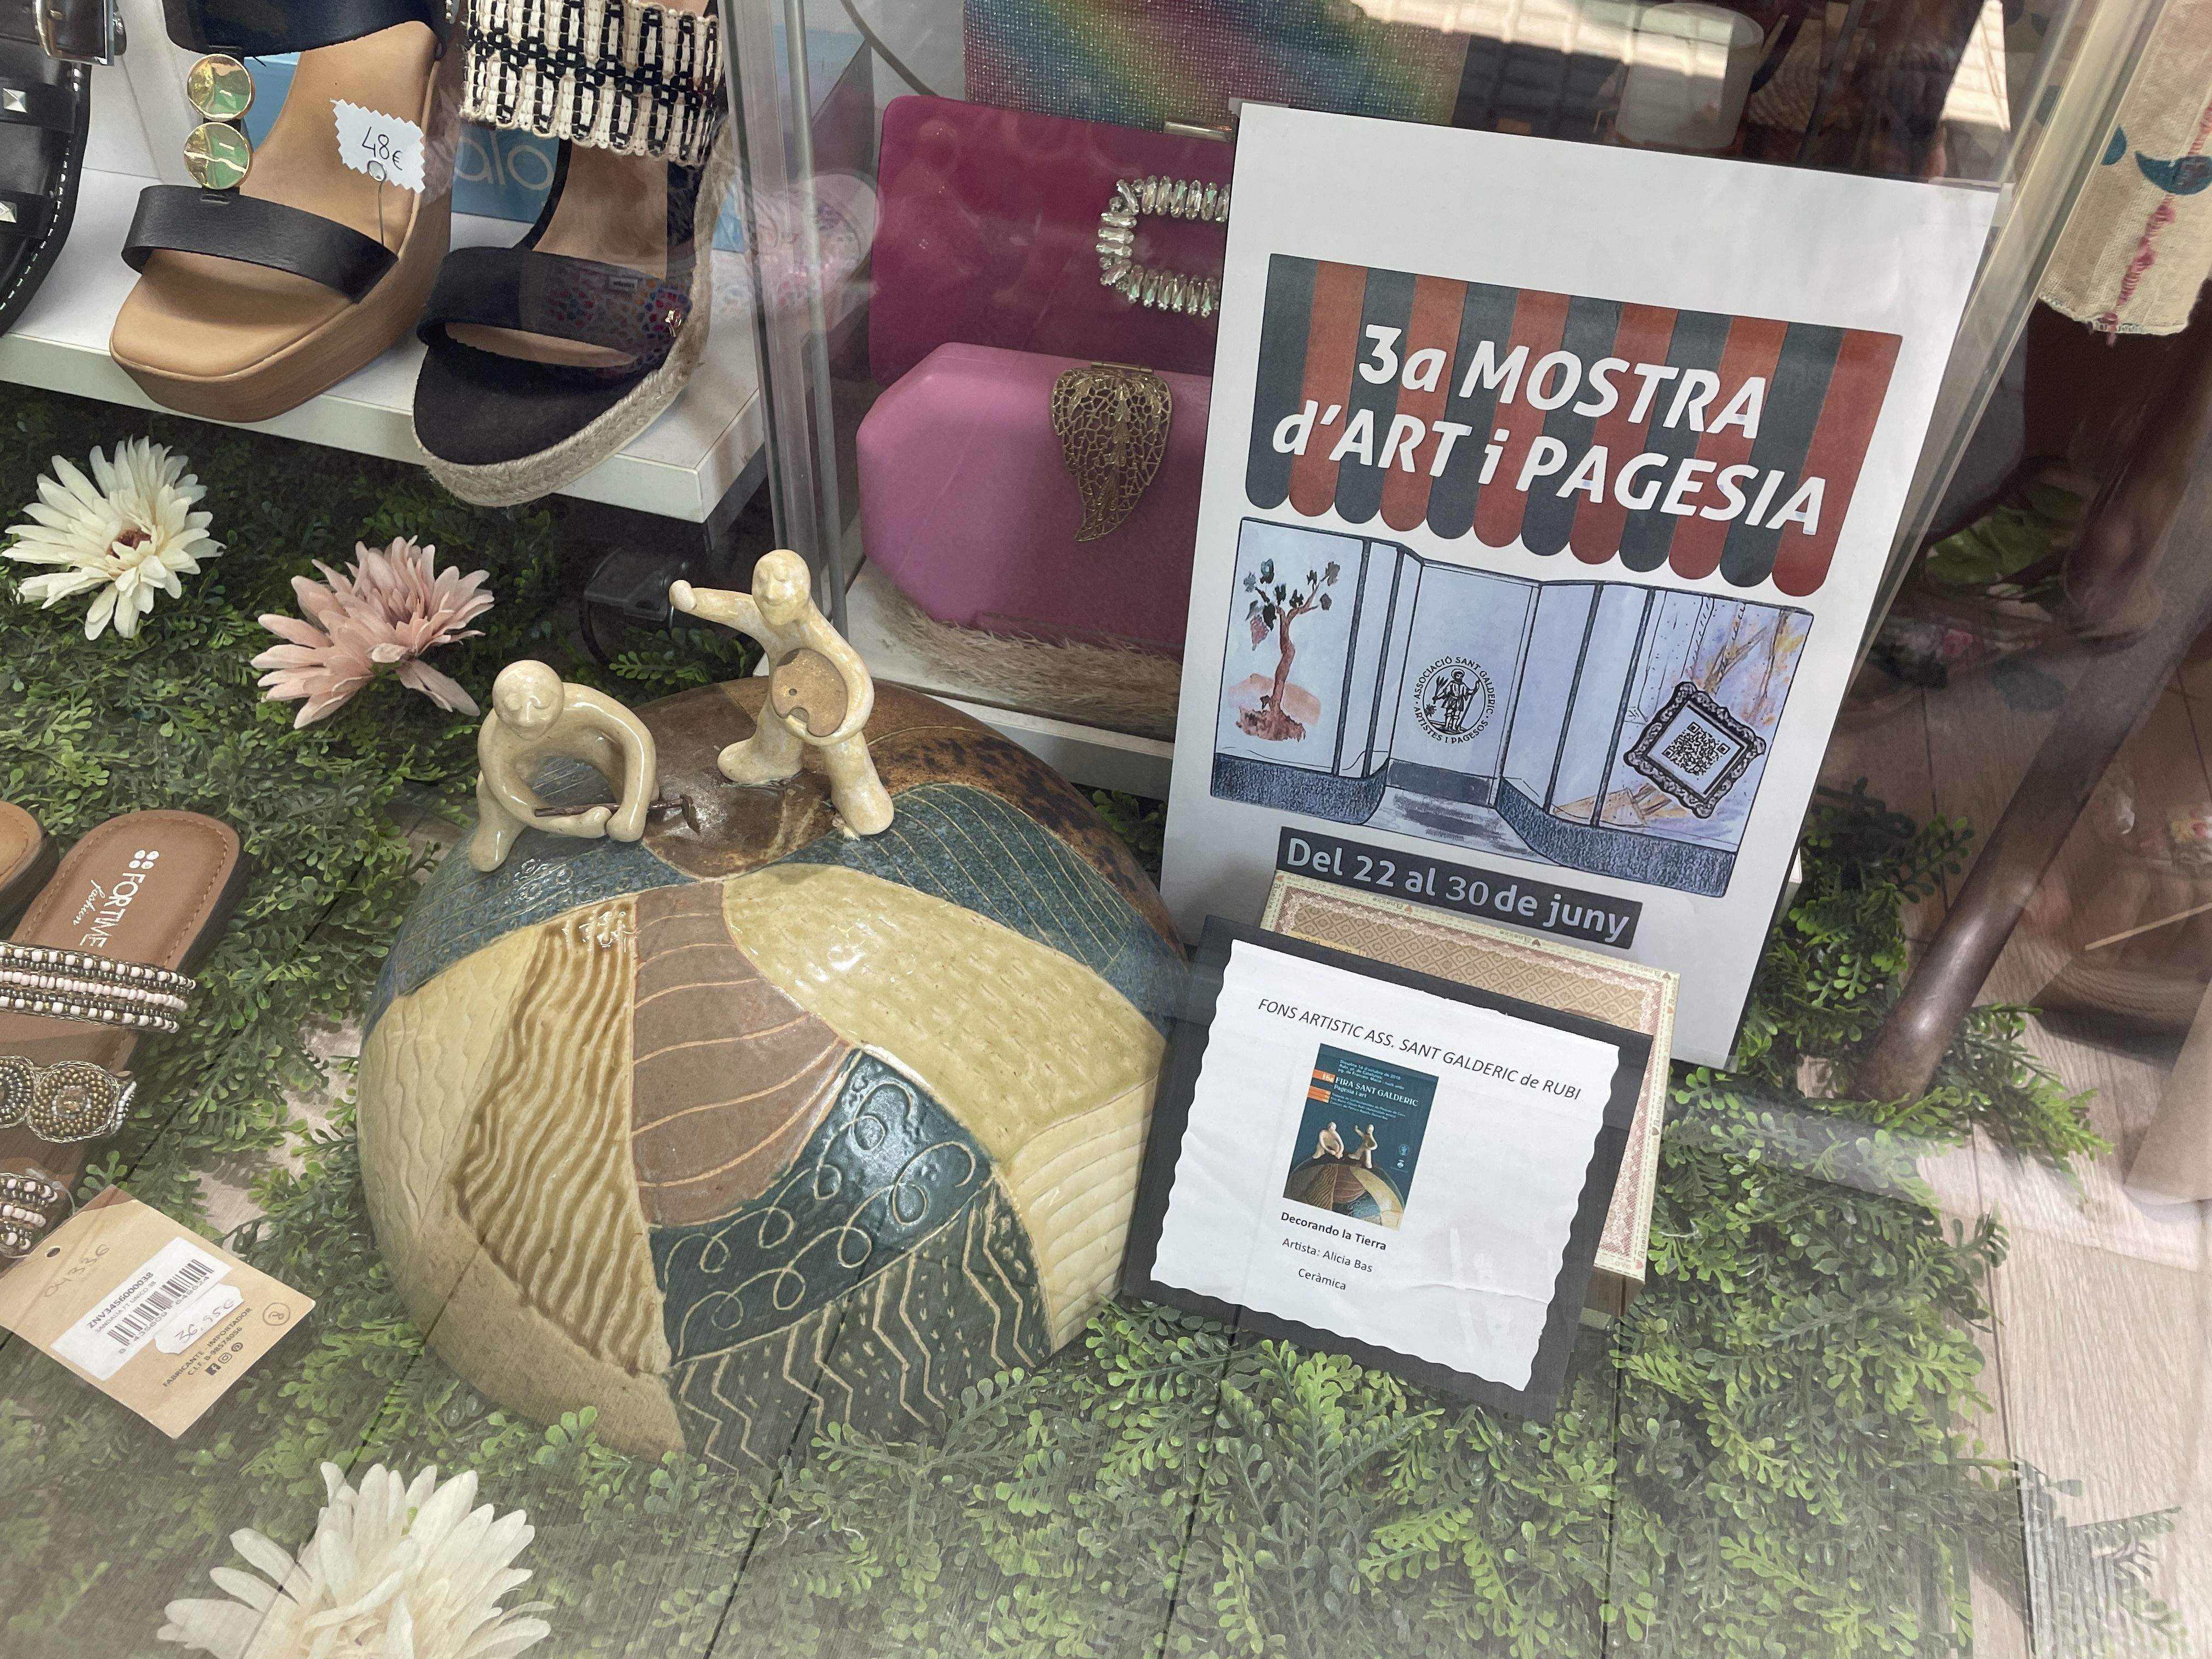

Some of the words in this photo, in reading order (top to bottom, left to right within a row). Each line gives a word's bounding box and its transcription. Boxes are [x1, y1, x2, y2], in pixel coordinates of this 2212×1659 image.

[362, 126, 403, 171] 48€
[1358, 324, 1447, 391] 3a
[1459, 340, 1767, 439] MOSTRA
[1272, 400, 1471, 477] d'ART
[1477, 428, 1508, 484] i
[1515, 435, 1827, 536] PAGESIA
[1414, 656, 1452, 699] ASSOCIACIÓ
[1455, 657, 1481, 671] SANT
[1480, 670, 1496, 714] GALDERIC
[1414, 707, 1443, 741] ARTISTES
[1451, 720, 1488, 744] PAGESOS
[1286, 837, 1343, 876] Del
[1353, 854, 1396, 888] 22
[1404, 867, 1436, 896] al
[1445, 876, 1488, 907] 30
[1495, 883, 1538, 917] de
[1543, 893, 1629, 942] juny
[1258, 998, 1297, 1019] FONS
[1299, 1011, 1364, 1039] ARTISTIC
[1364, 1029, 1395, 1048] ASS.
[1399, 1038, 1442, 1060] SANT
[1443, 1051, 1518, 1082] GALDERIC
[1520, 1073, 1539, 1090] de
[1542, 1079, 1582, 1101] RUBI
[1335, 1077, 1353, 1088] FIRA
[1355, 1083, 1376, 1094] SANT
[1377, 1089, 1419, 1107] GALDERIC
[1281, 1212, 1339, 1237] Decorando
[1341, 1229, 1352, 1240] la
[1355, 1233, 1386, 1250] Tierra
[1282, 1238, 1320, 1256] Artista:
[1323, 1250, 1351, 1266] Alicia
[1354, 1259, 1373, 1272] Bas
[1298, 1268, 1346, 1290] Ceràmica
[161, 1350, 205, 1387] FABRICANTE
[206, 1306, 252, 1347] IMPORTADOR
